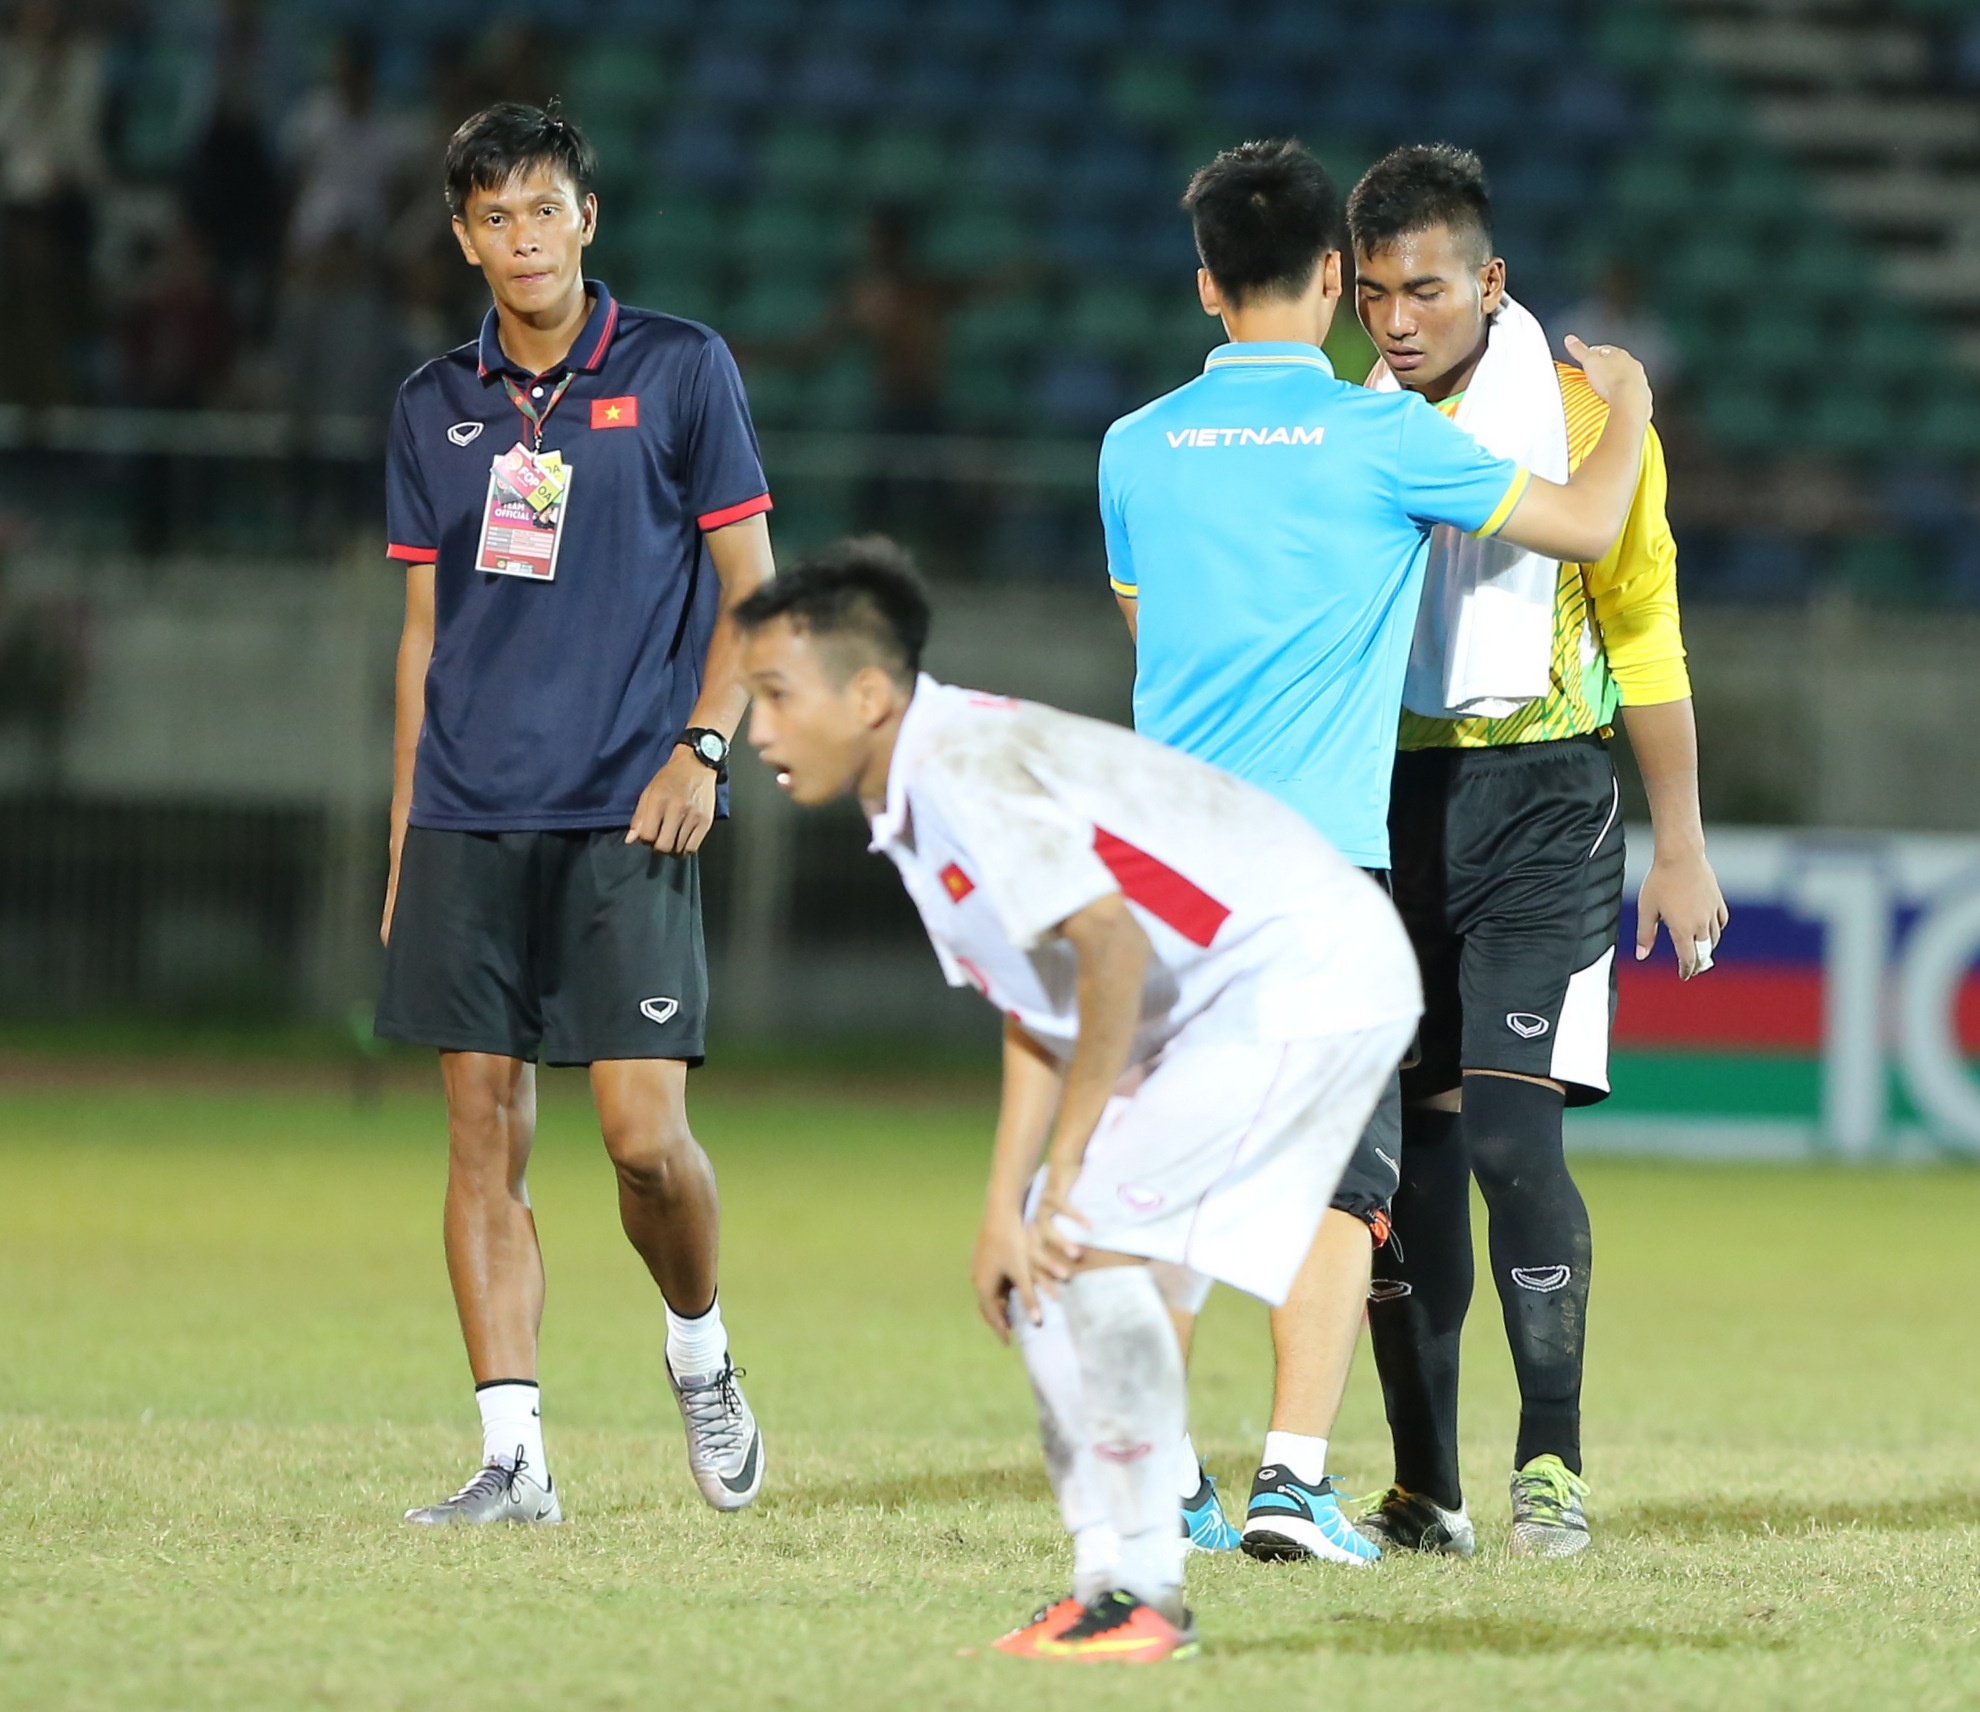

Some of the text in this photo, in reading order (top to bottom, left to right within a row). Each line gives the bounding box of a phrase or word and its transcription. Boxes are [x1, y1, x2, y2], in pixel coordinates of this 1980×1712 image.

[1166, 426, 1325, 448] VIETNAM
[518, 466, 540, 487] FOP
[537, 485, 552, 502] OA
[494, 508, 530, 520] OFFICIAL
